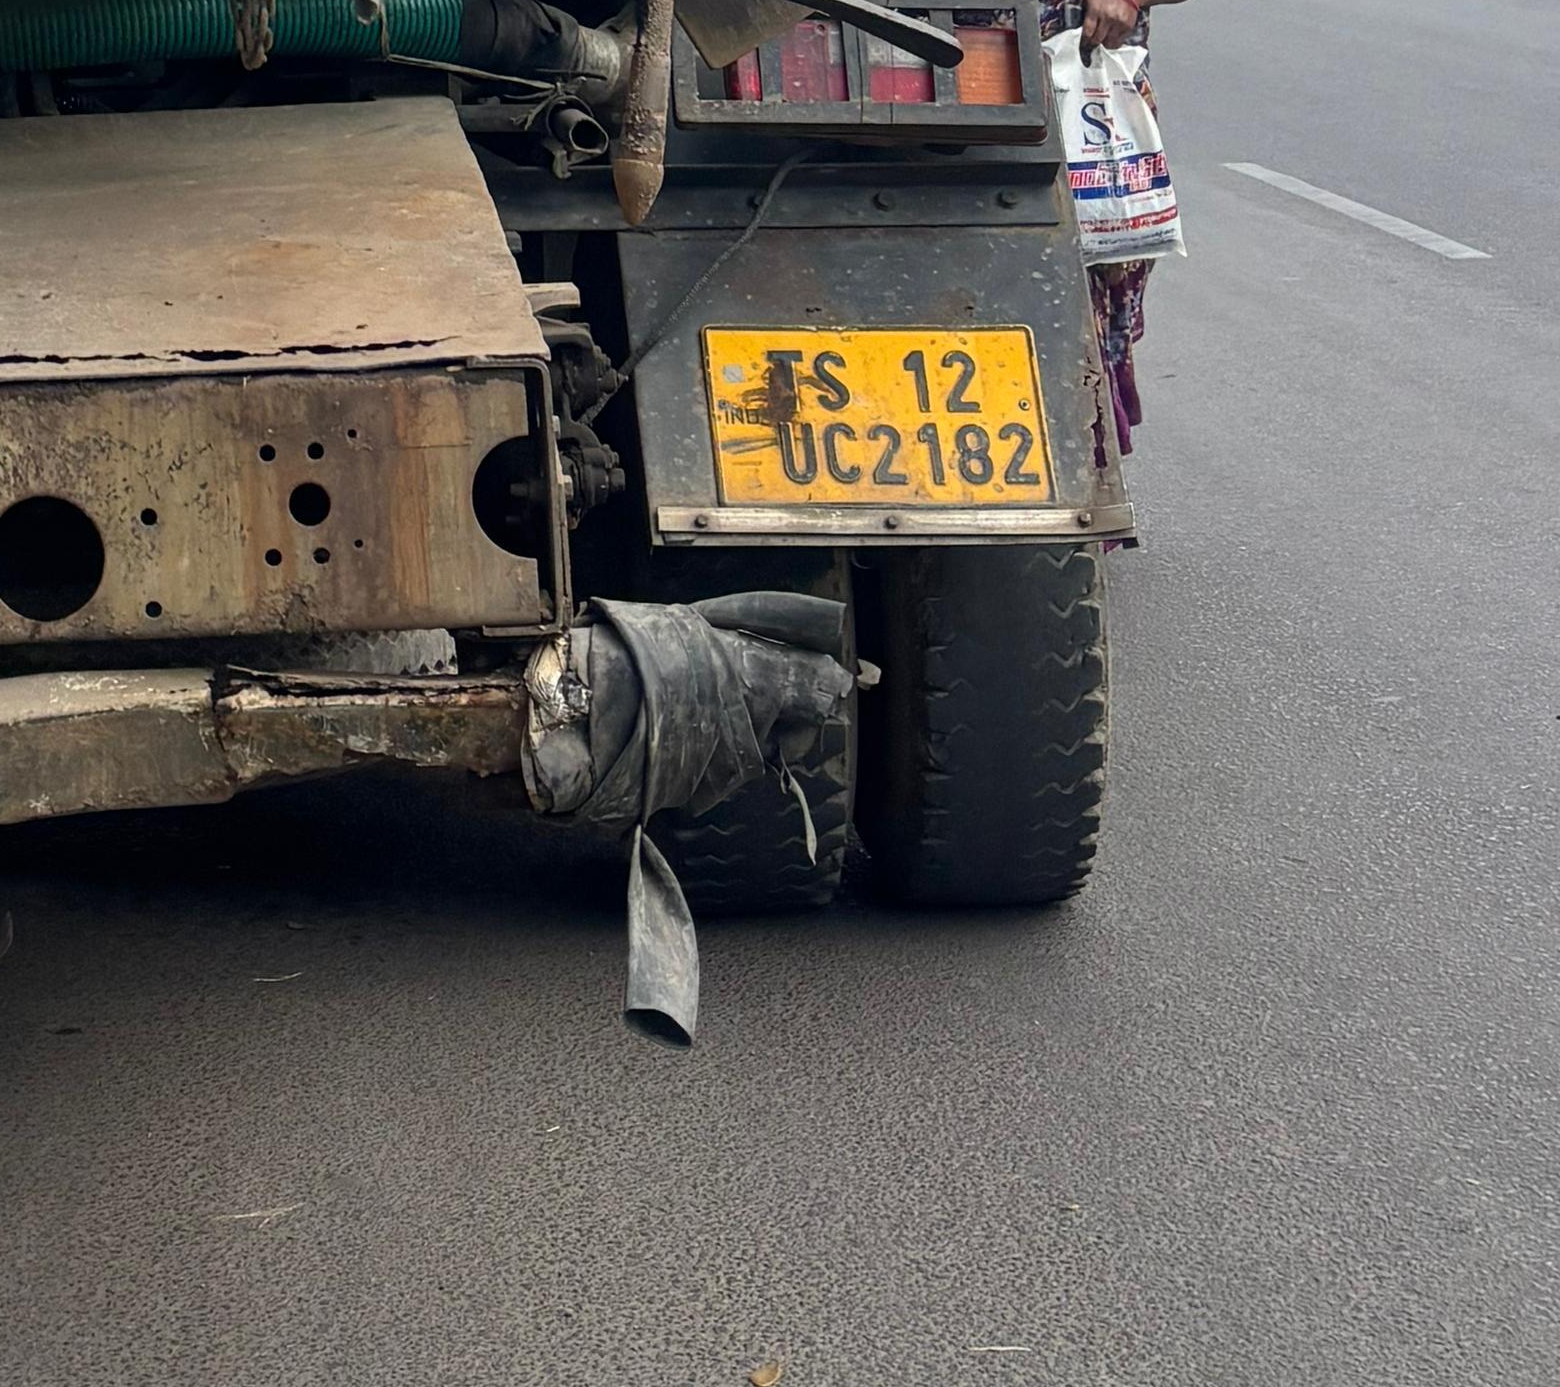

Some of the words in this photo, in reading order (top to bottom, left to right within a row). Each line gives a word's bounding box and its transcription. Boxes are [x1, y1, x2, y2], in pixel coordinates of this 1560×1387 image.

[765, 349, 852, 413] TS
[903, 350, 981, 414] 12
[776, 422, 1041, 485] UC2182
